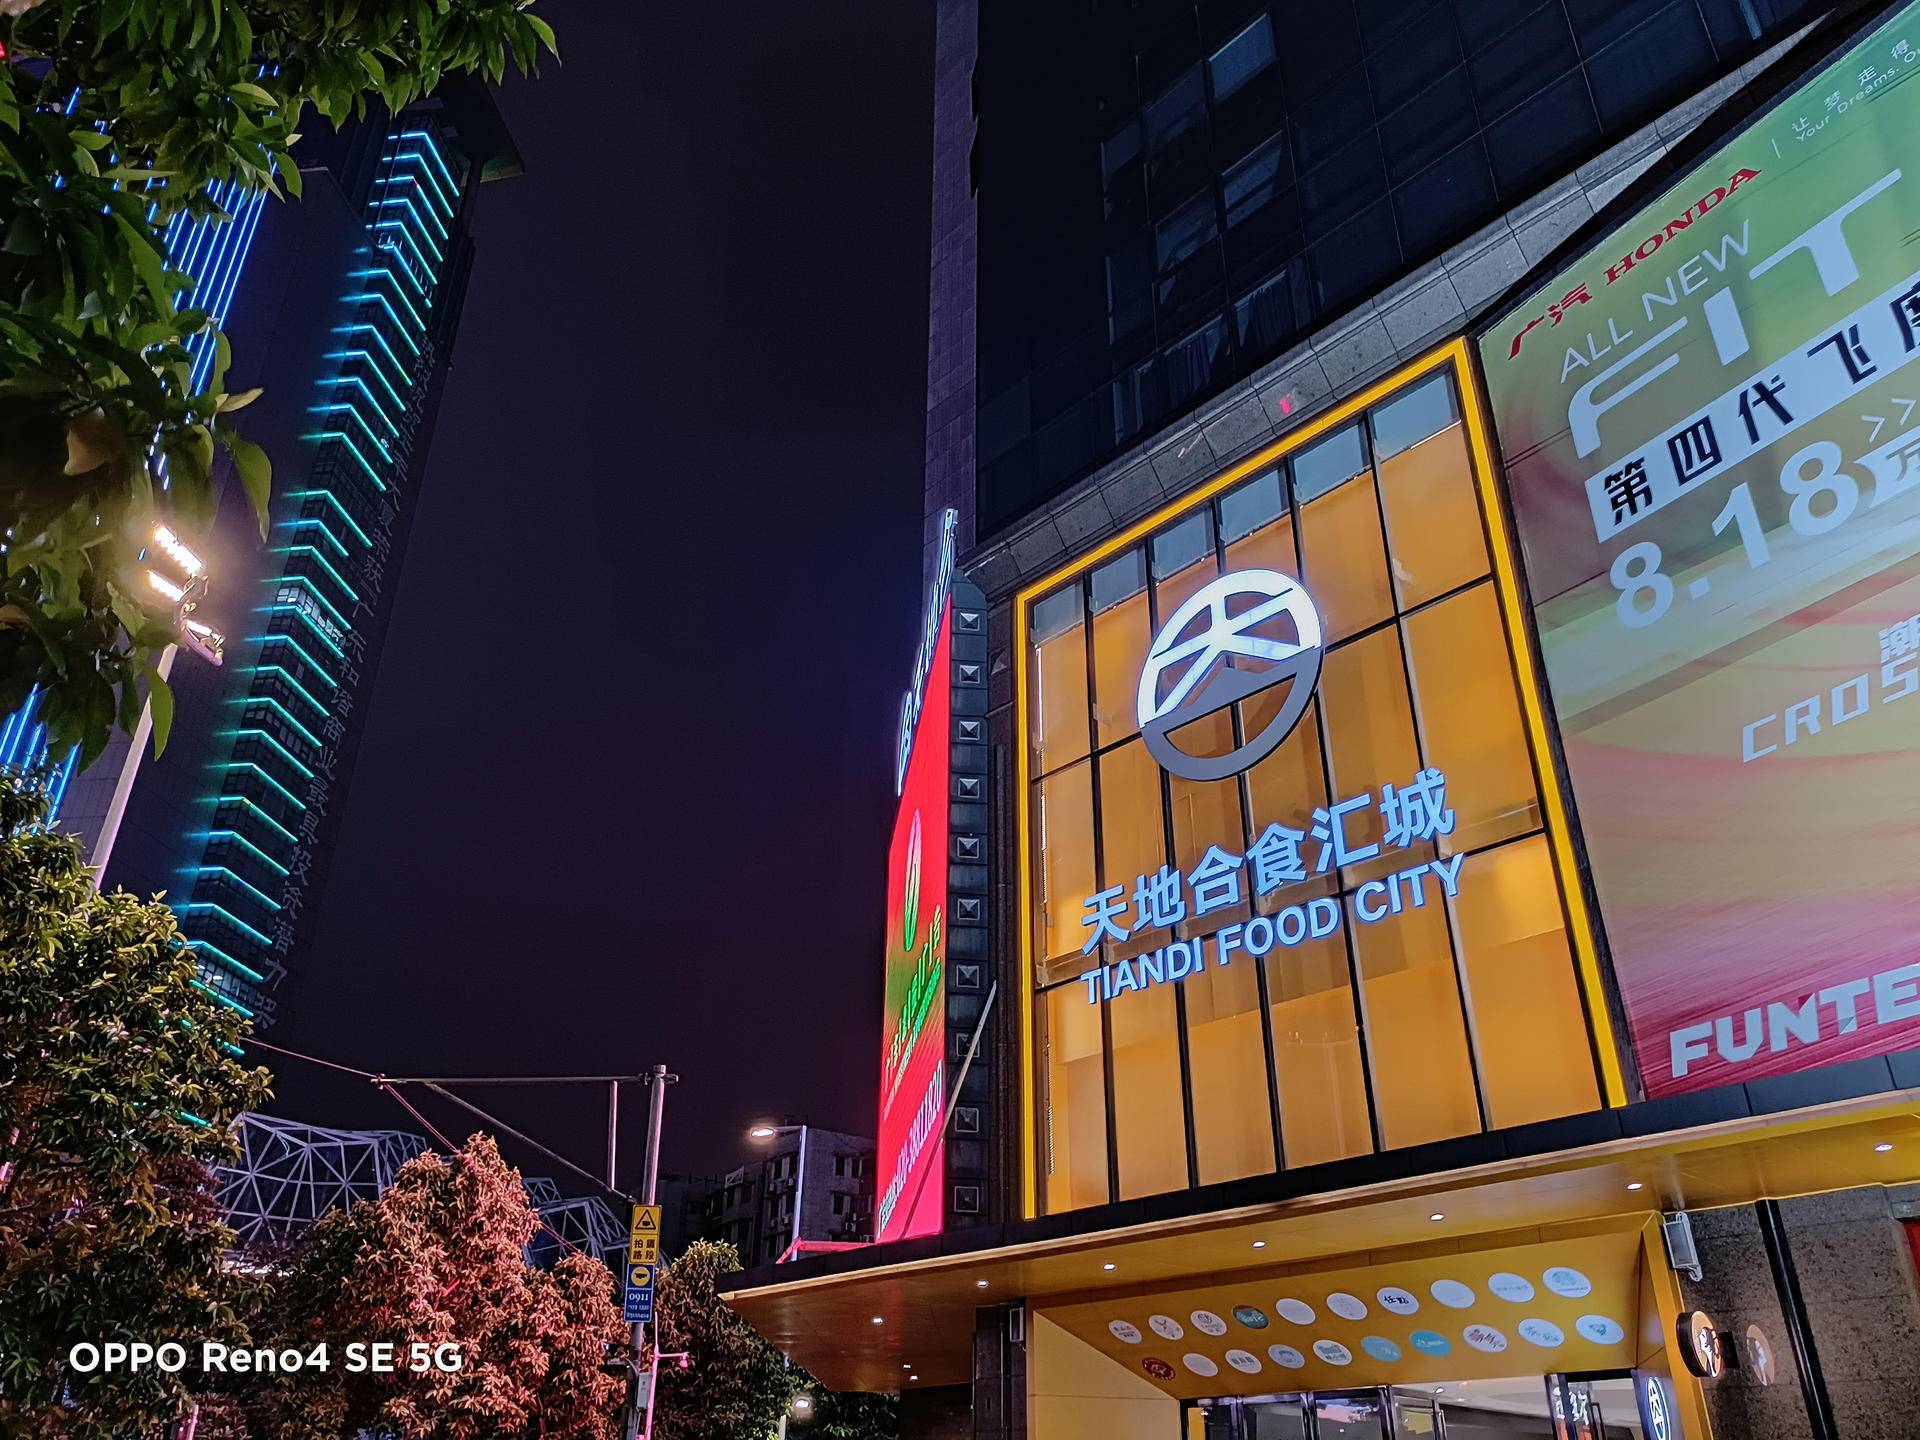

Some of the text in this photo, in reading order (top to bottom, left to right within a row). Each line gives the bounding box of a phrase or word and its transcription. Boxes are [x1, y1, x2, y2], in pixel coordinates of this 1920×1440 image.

[1796, 115, 1831, 142] Your
[1837, 66, 1900, 114] Dreams.
[1606, 167, 1762, 286] HONDA
[1560, 219, 1750, 384] ALL NEW
[1609, 441, 1859, 628] 8.18
[1080, 766, 1456, 956] 天地合食汇城
[1080, 853, 1466, 1005] TIANDI FOOD CITY
[1669, 962, 1920, 1078] FUNTE
[628, 1292, 649, 1302] 0911
